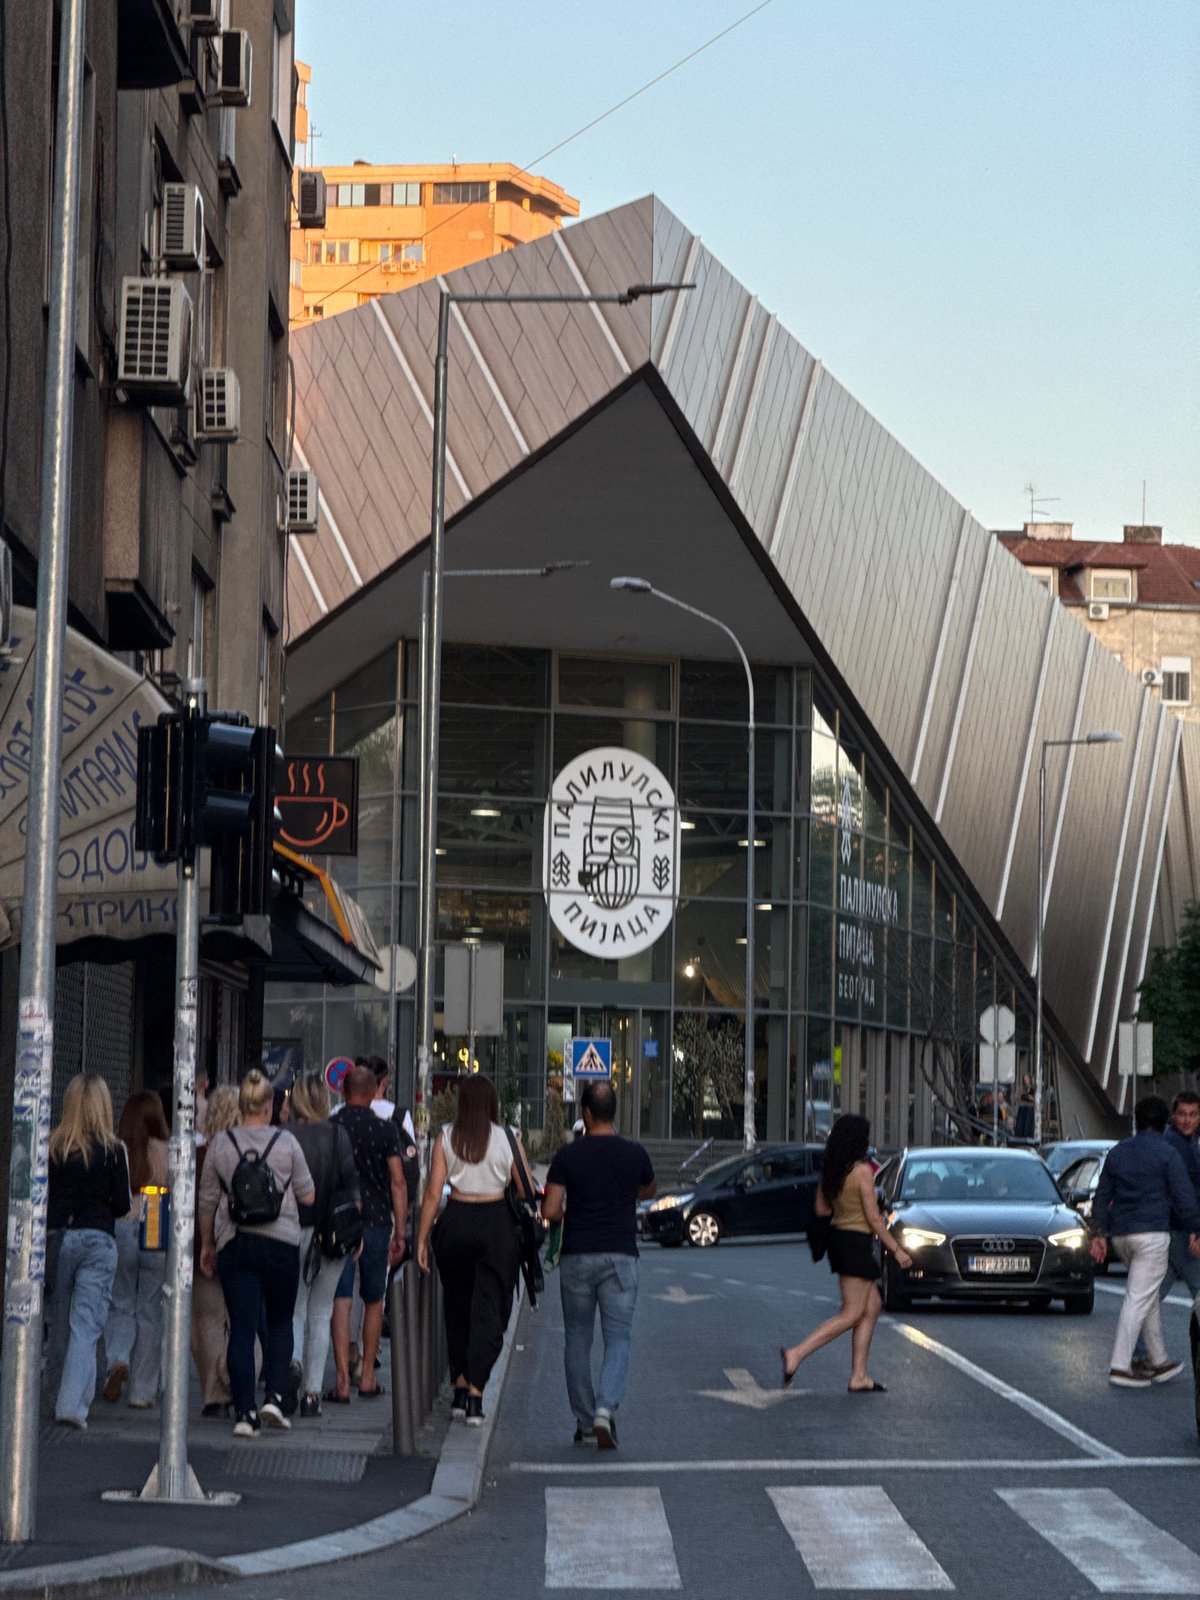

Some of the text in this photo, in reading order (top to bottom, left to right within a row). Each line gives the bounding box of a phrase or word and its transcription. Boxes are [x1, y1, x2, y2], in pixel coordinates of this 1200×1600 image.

[553, 760, 671, 845] ПАЛИЛУЛСКА
[840, 873, 899, 923] ПАЛИЛУЛСКА
[563, 901, 661, 945] ПИЈАЦА
[839, 921, 875, 967] ПИЈАЦА
[838, 972, 875, 1007] БЕОГРАД
